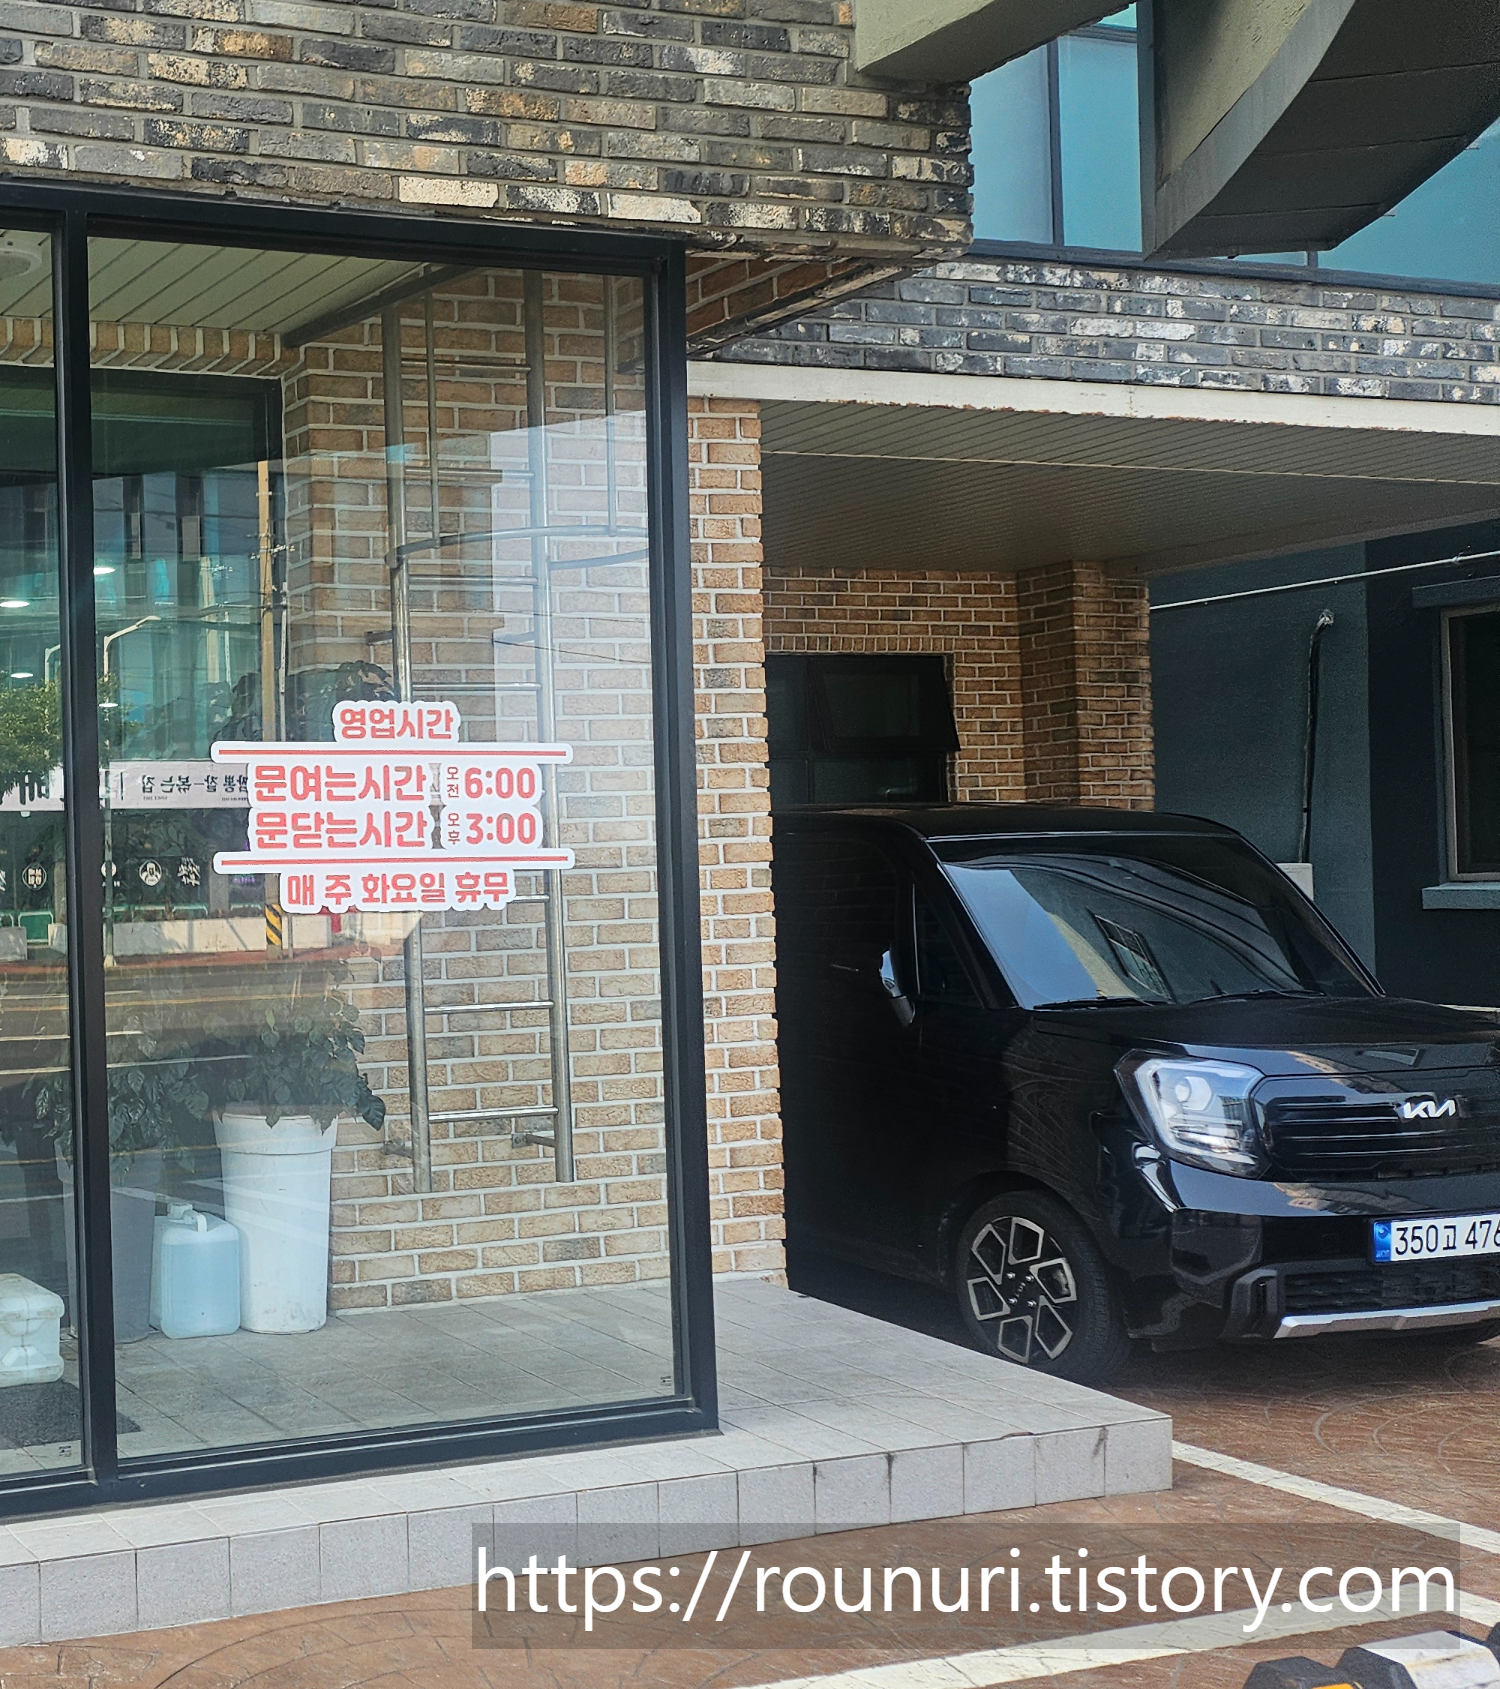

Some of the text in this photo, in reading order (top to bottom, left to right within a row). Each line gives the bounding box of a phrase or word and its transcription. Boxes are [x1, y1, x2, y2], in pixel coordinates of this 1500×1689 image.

[340, 708, 454, 740] 영업시간
[254, 765, 426, 802] 문여는시간
[465, 767, 536, 799] 6:00
[255, 811, 427, 849] 문닫는시간
[466, 812, 537, 844] 3:00
[287, 872, 510, 905] 매 주 화요일 휴무
